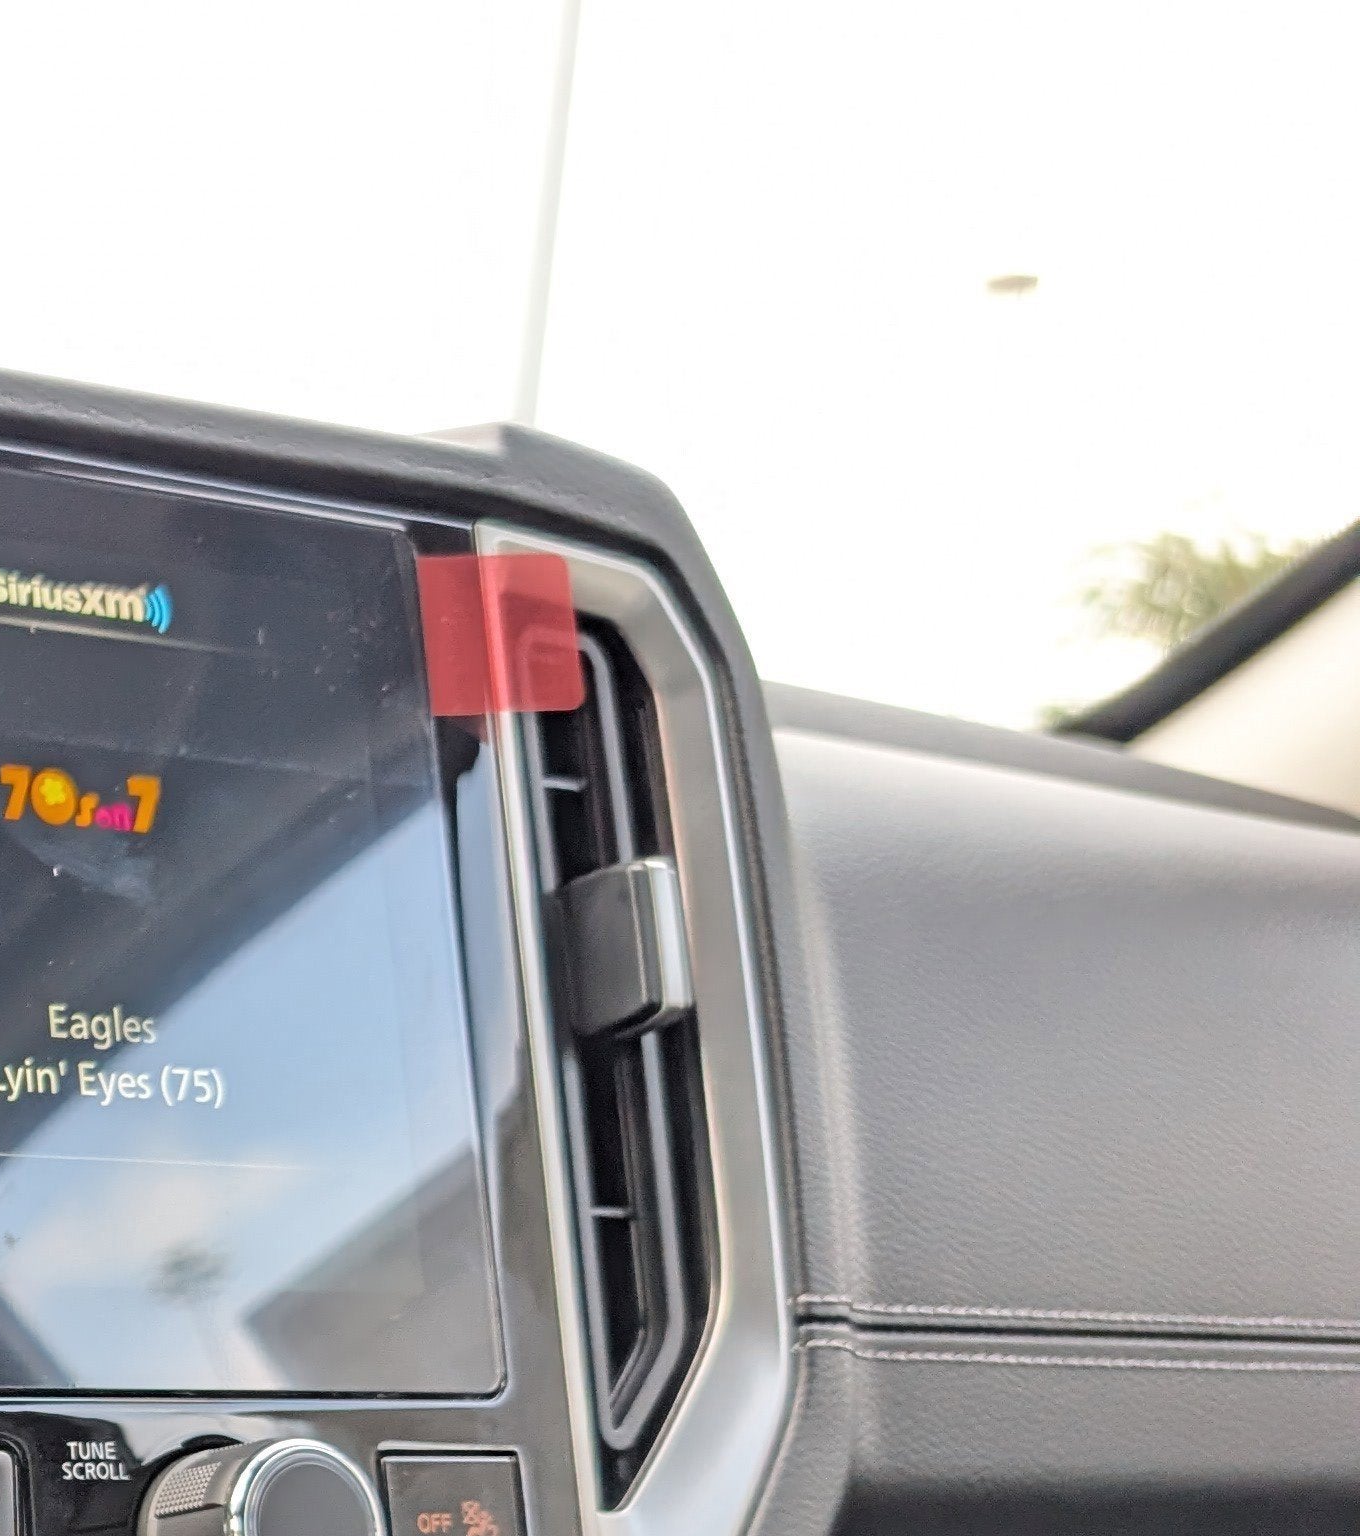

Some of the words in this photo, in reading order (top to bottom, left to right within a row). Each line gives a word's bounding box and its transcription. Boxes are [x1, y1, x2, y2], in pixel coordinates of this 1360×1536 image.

[49, 1004, 157, 1048] Eagles
[79, 1063, 151, 1103] Eyes
[161, 1066, 225, 1108] (75)
[67, 1441, 116, 1460] TUNE
[62, 1462, 129, 1481] SCROLL
[416, 1511, 452, 1535] OFF
